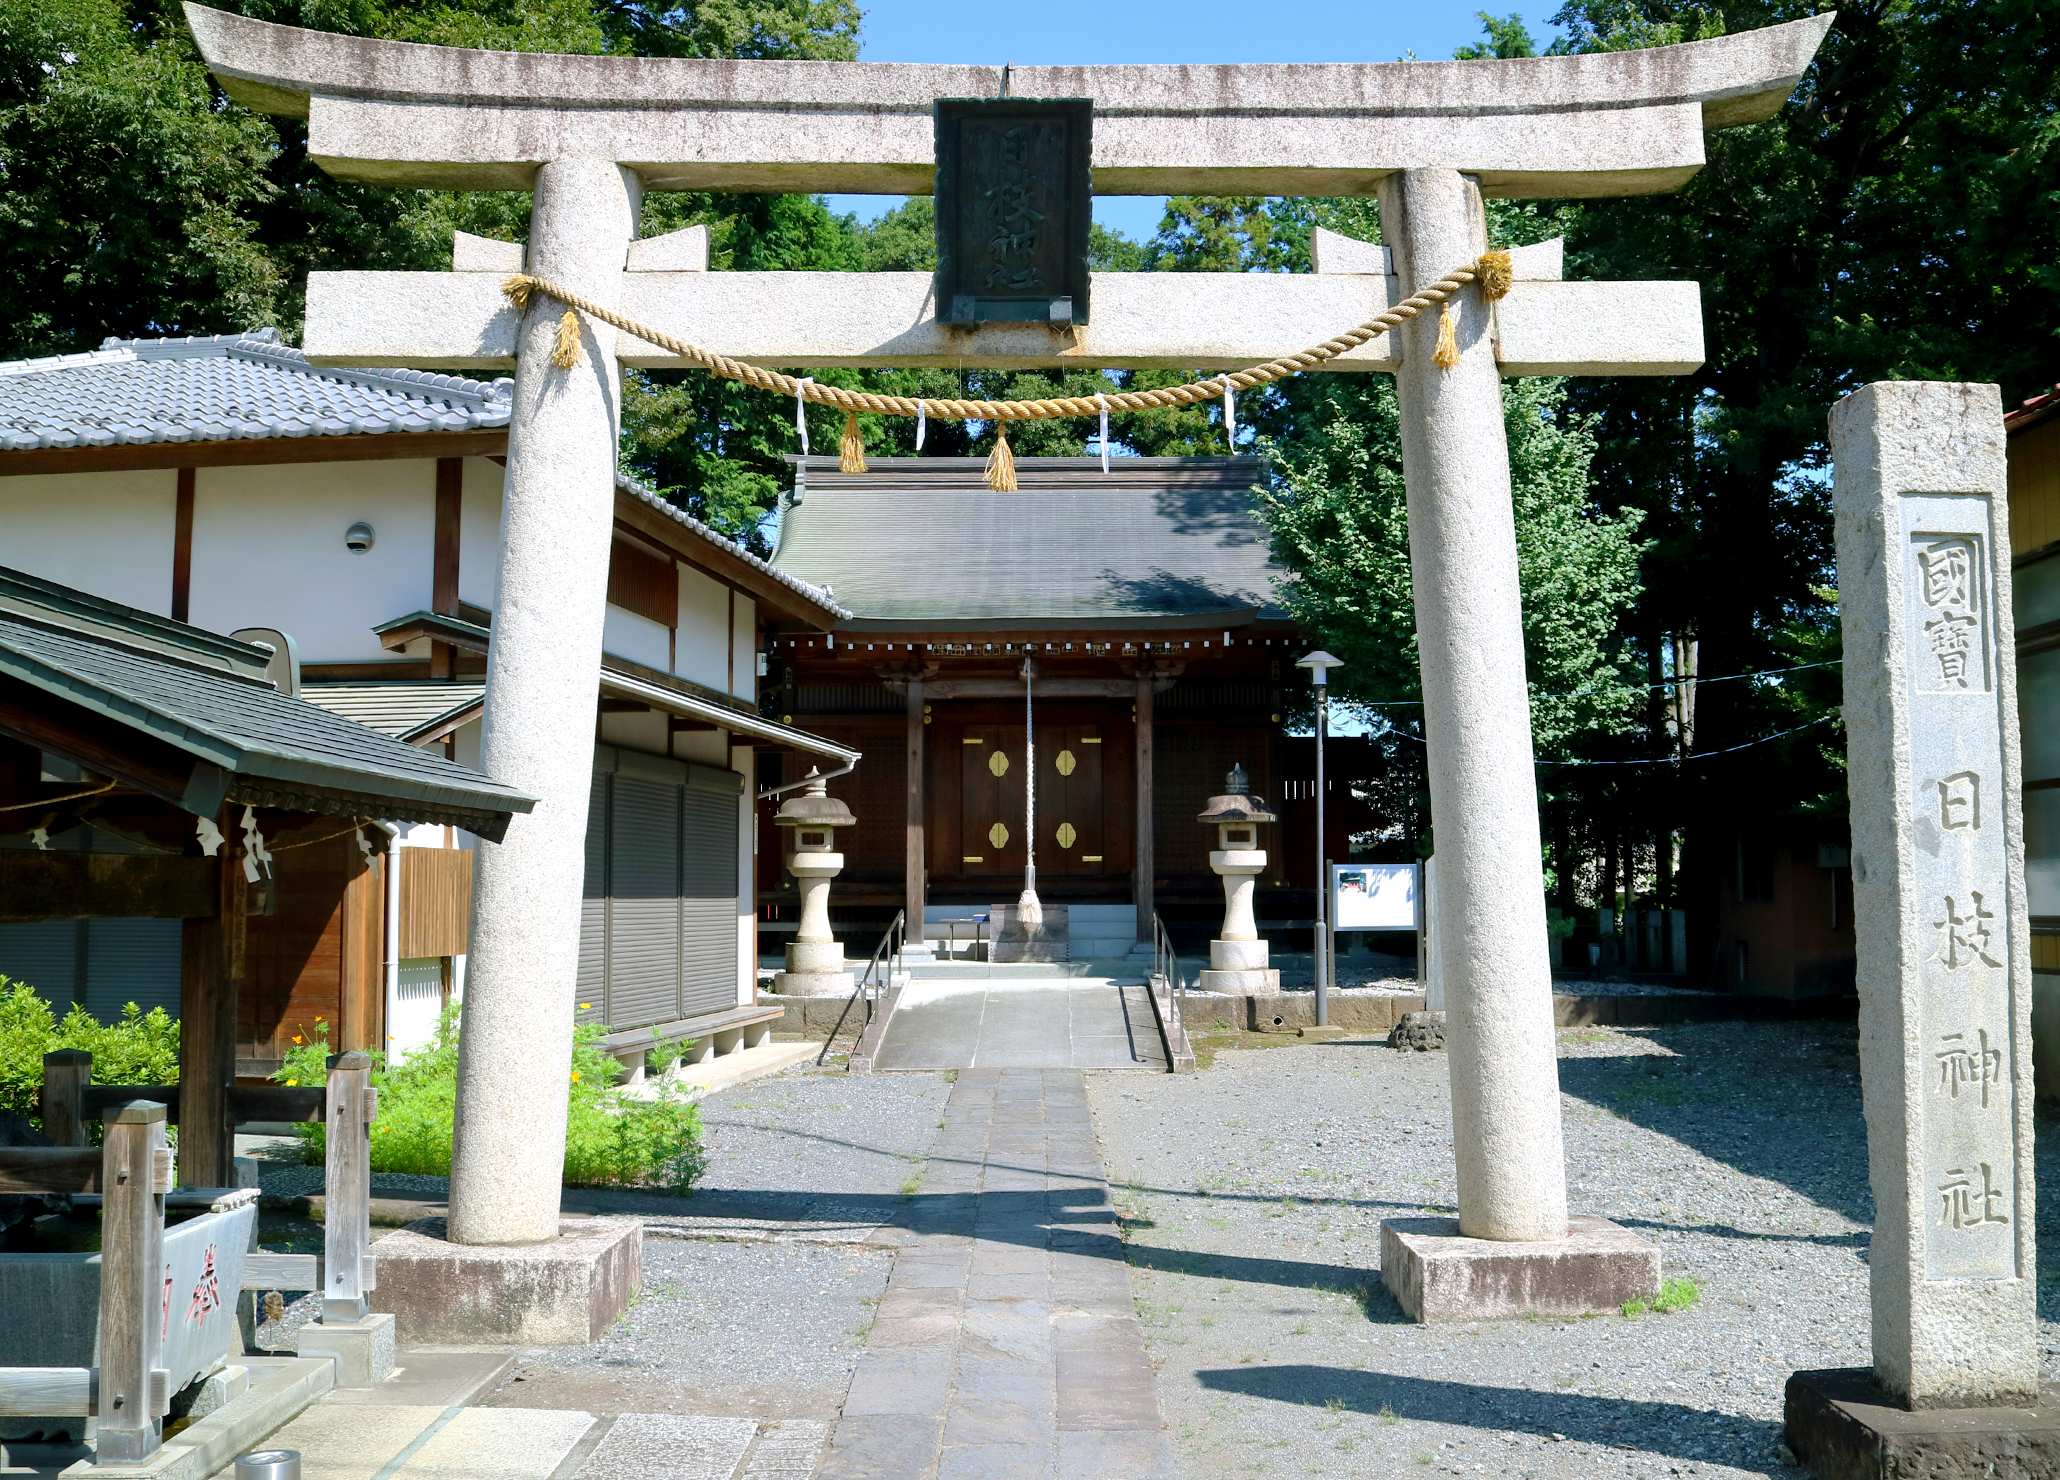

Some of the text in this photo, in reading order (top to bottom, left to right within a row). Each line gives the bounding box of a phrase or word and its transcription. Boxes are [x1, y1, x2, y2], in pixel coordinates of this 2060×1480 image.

[985, 125, 1045, 290] 日枝神社
[1927, 770, 2008, 1229] 日枝神社
